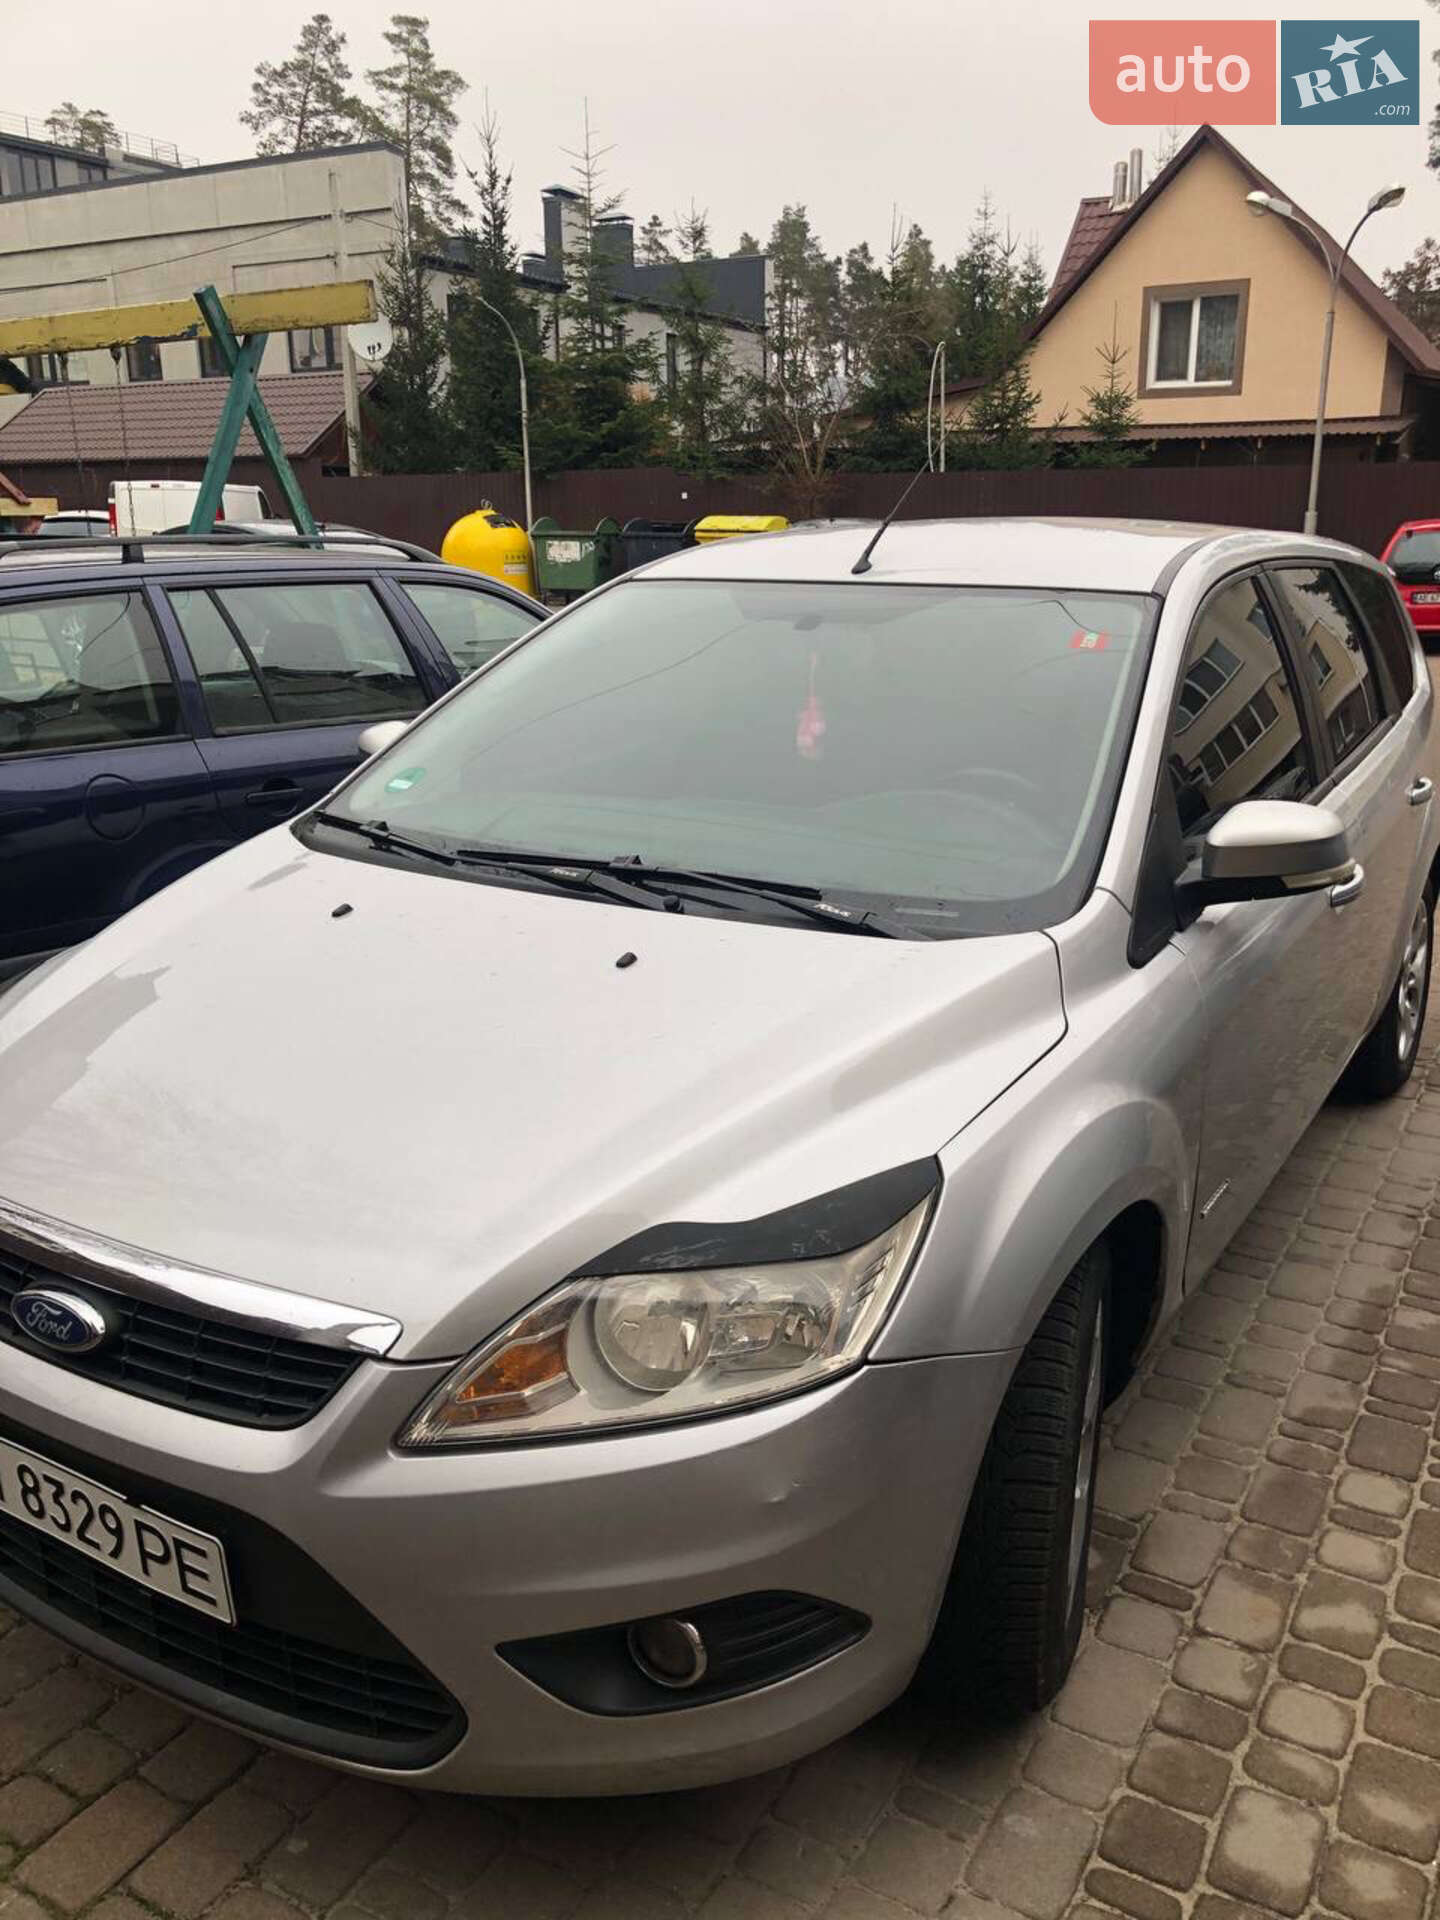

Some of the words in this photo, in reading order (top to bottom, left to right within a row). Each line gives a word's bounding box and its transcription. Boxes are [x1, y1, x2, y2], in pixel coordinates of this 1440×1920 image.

[26, 1301, 72, 1341] Ford
[17, 1463, 125, 1560] 8329
[134, 1518, 218, 1608] PE
